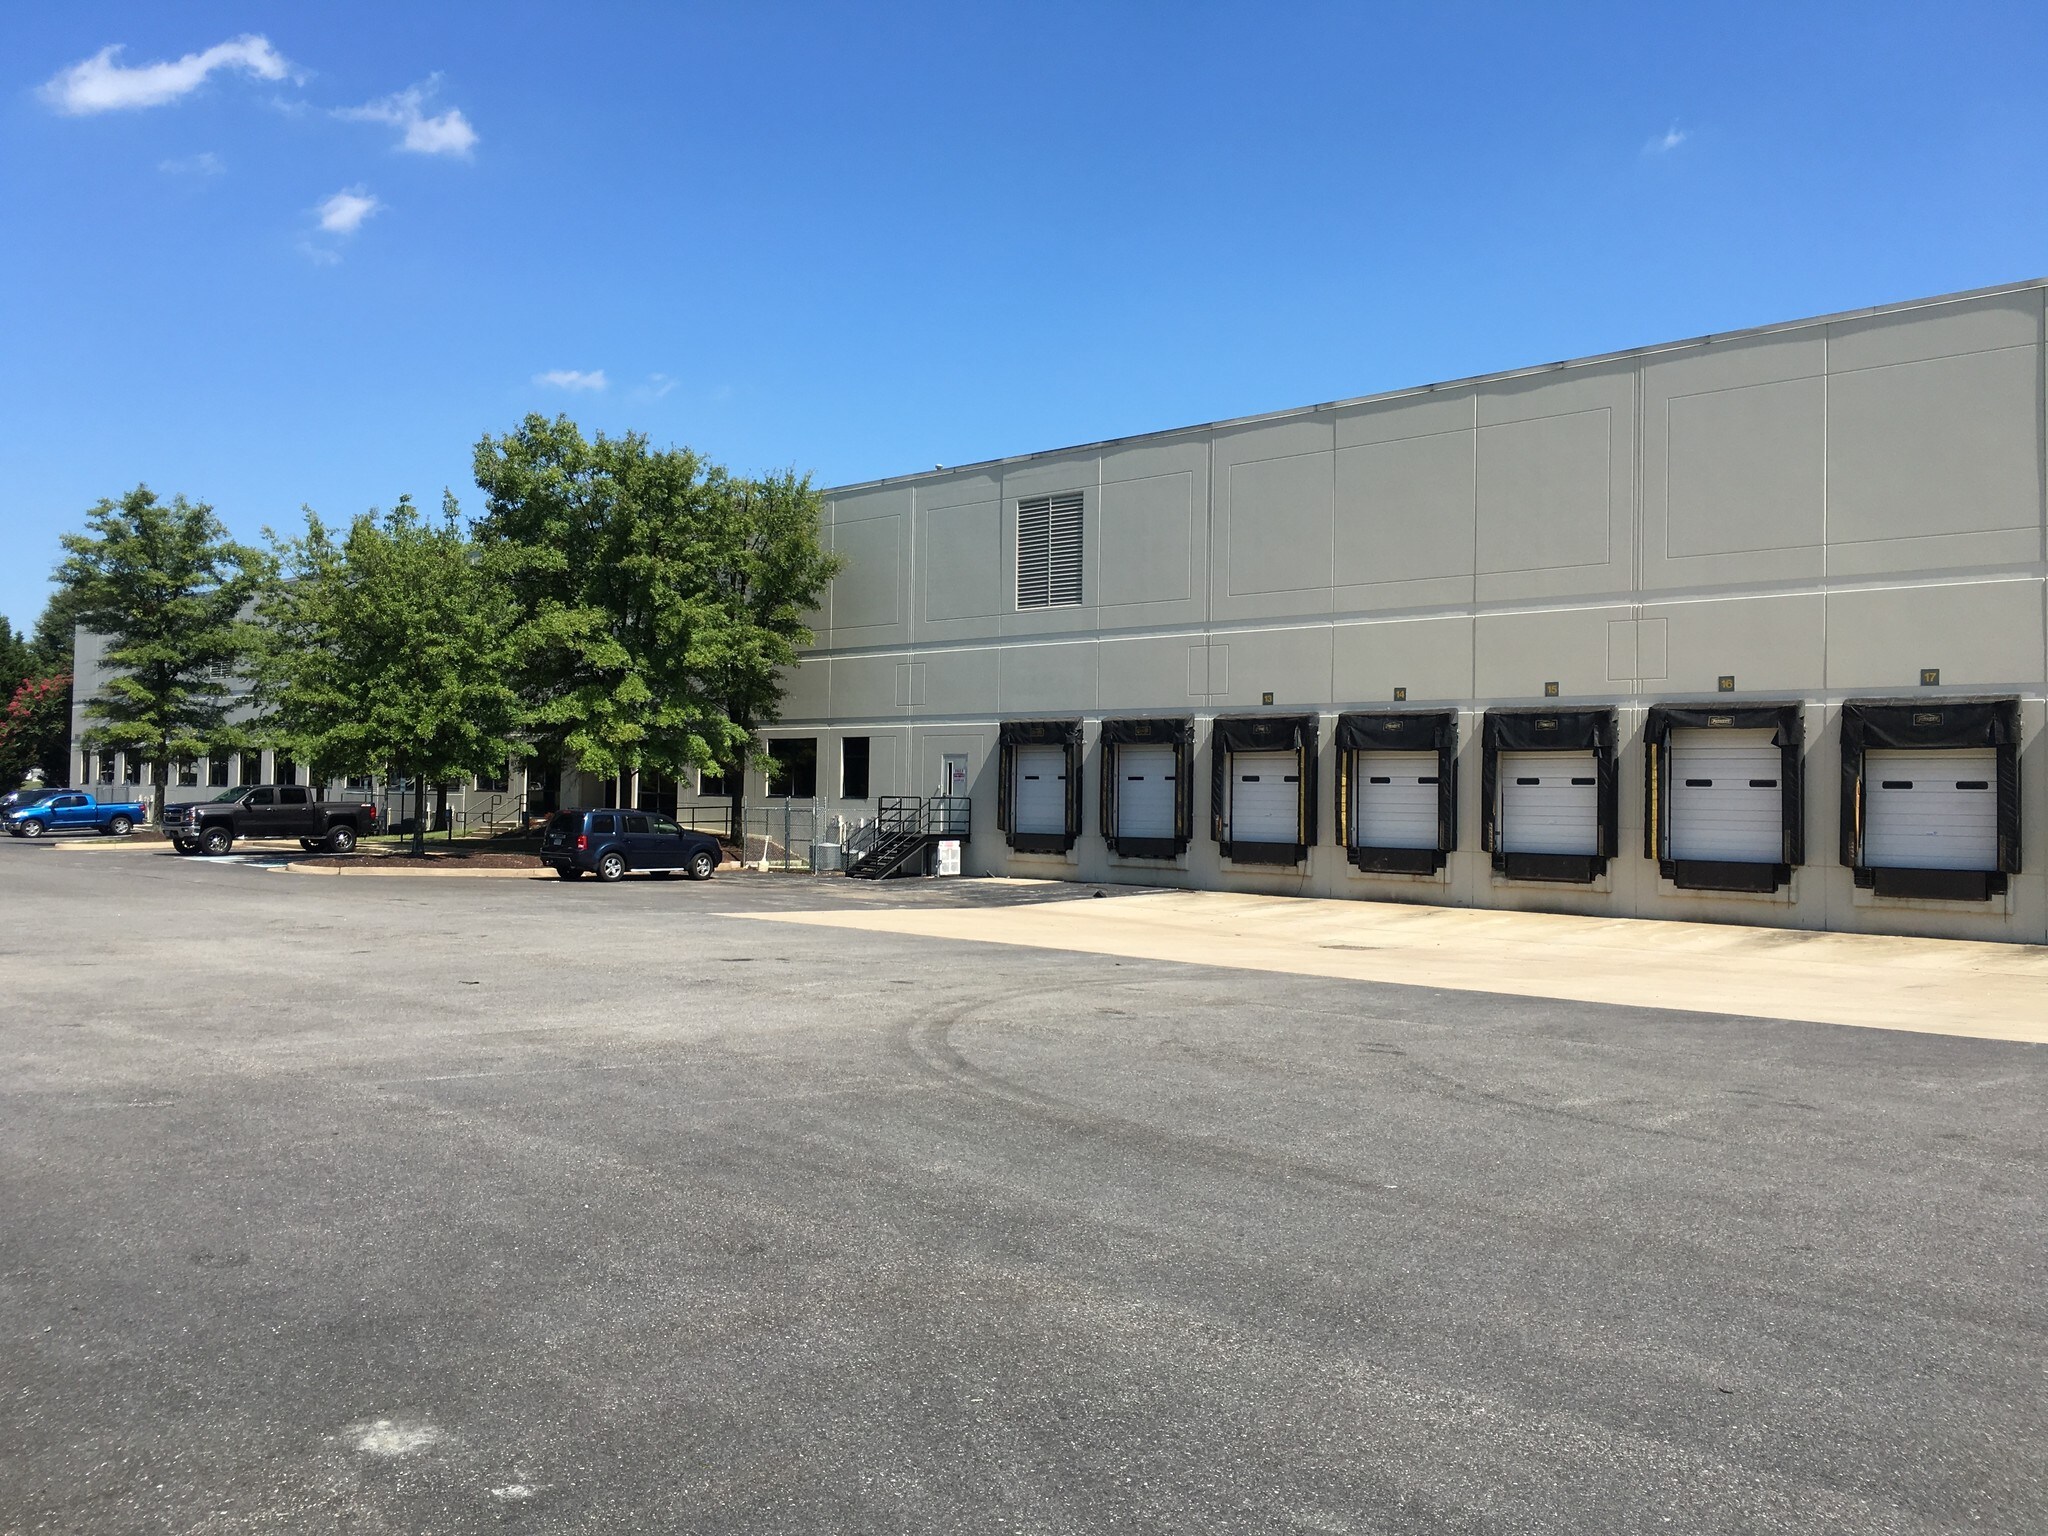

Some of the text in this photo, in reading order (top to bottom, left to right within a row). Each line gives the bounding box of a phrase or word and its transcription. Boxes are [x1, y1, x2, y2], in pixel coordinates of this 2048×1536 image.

[1925, 672, 1936, 682] 17
[1721, 680, 1732, 688] 16
[1547, 685, 1557, 694] 15
[1396, 690, 1404, 698] 14
